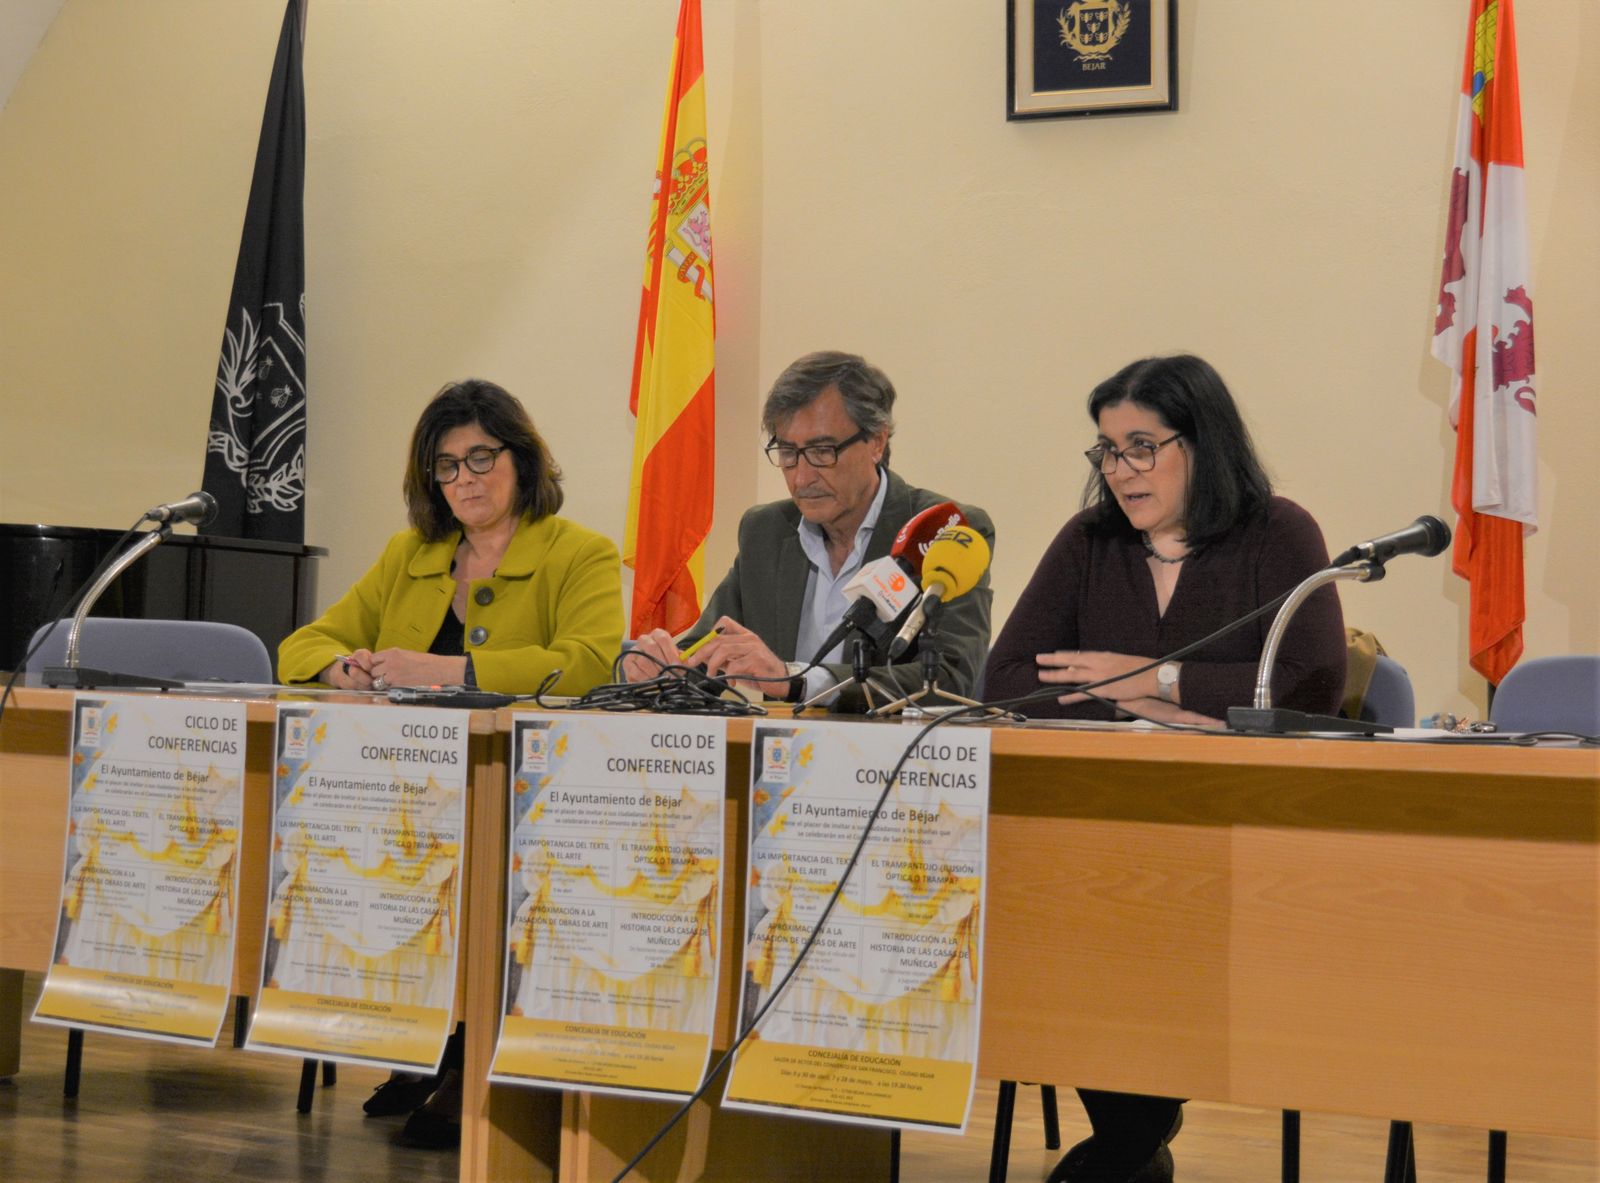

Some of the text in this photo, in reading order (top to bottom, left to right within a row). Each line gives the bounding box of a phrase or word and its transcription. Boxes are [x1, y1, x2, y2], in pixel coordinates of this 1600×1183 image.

[184, 715, 238, 731] CICLO DE
[400, 724, 459, 740] CICLO DE
[148, 735, 237, 754] CONFERENCIAS
[650, 733, 715, 749] CICLO DE
[360, 745, 458, 764] CONFERENCIAS
[955, 747, 976, 762] DE
[606, 757, 715, 775] CONFERENCIAS
[101, 764, 209, 785] El Ayuntamiento de Béjar
[855, 768, 976, 789] CONERENCIAS
[308, 776, 428, 797] El Ayuntamiento de Béjar
[549, 791, 682, 810] El Ayuntamiento de Béjar
[792, 803, 801, 814] El
[891, 808, 905, 820] de
[909, 809, 939, 825] Béjar
[528, 839, 574, 848] IMPORTANCIA
[546, 851, 582, 860] EN EL ARTE
[767, 853, 818, 863] IMPORTANCIA
[820, 856, 833, 864] DEL
[787, 866, 827, 876] EN EL ARTE
[646, 935, 680, 945] MUÑECAS
[870, 943, 904, 953] HISTORIA
[906, 946, 915, 954] DE
[918, 947, 931, 955] LAS
[959, 950, 968, 959] DE
[899, 956, 937, 968] MUÑECAS
[808, 1050, 902, 1066] CONCEJALÍA DE EDUCACIÓN
